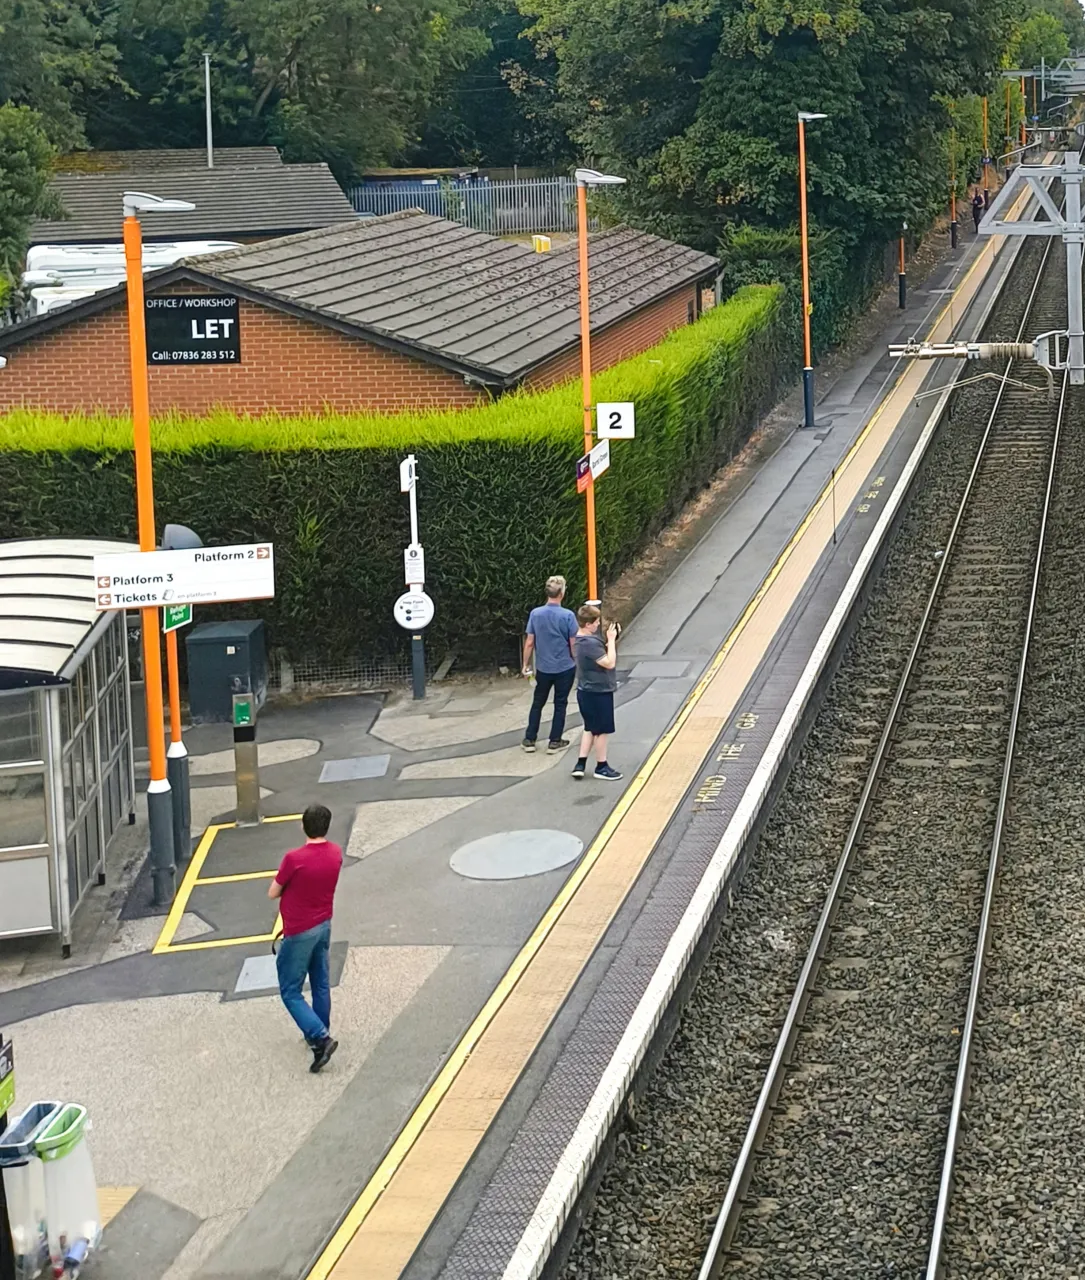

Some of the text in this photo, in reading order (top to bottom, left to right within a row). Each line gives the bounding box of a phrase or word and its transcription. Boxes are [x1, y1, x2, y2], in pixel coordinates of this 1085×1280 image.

[146, 299, 177, 308] OFFICE
[184, 298, 236, 308] WORKSHOP
[191, 319, 234, 338] LET
[152, 350, 235, 360] Call: 07836 283 512
[609, 412, 622, 429] 2
[194, 550, 255, 563] Platform 2
[113, 573, 174, 586] Platform 3
[114, 593, 157, 604] Tickets
[716, 743, 746, 762] THE
